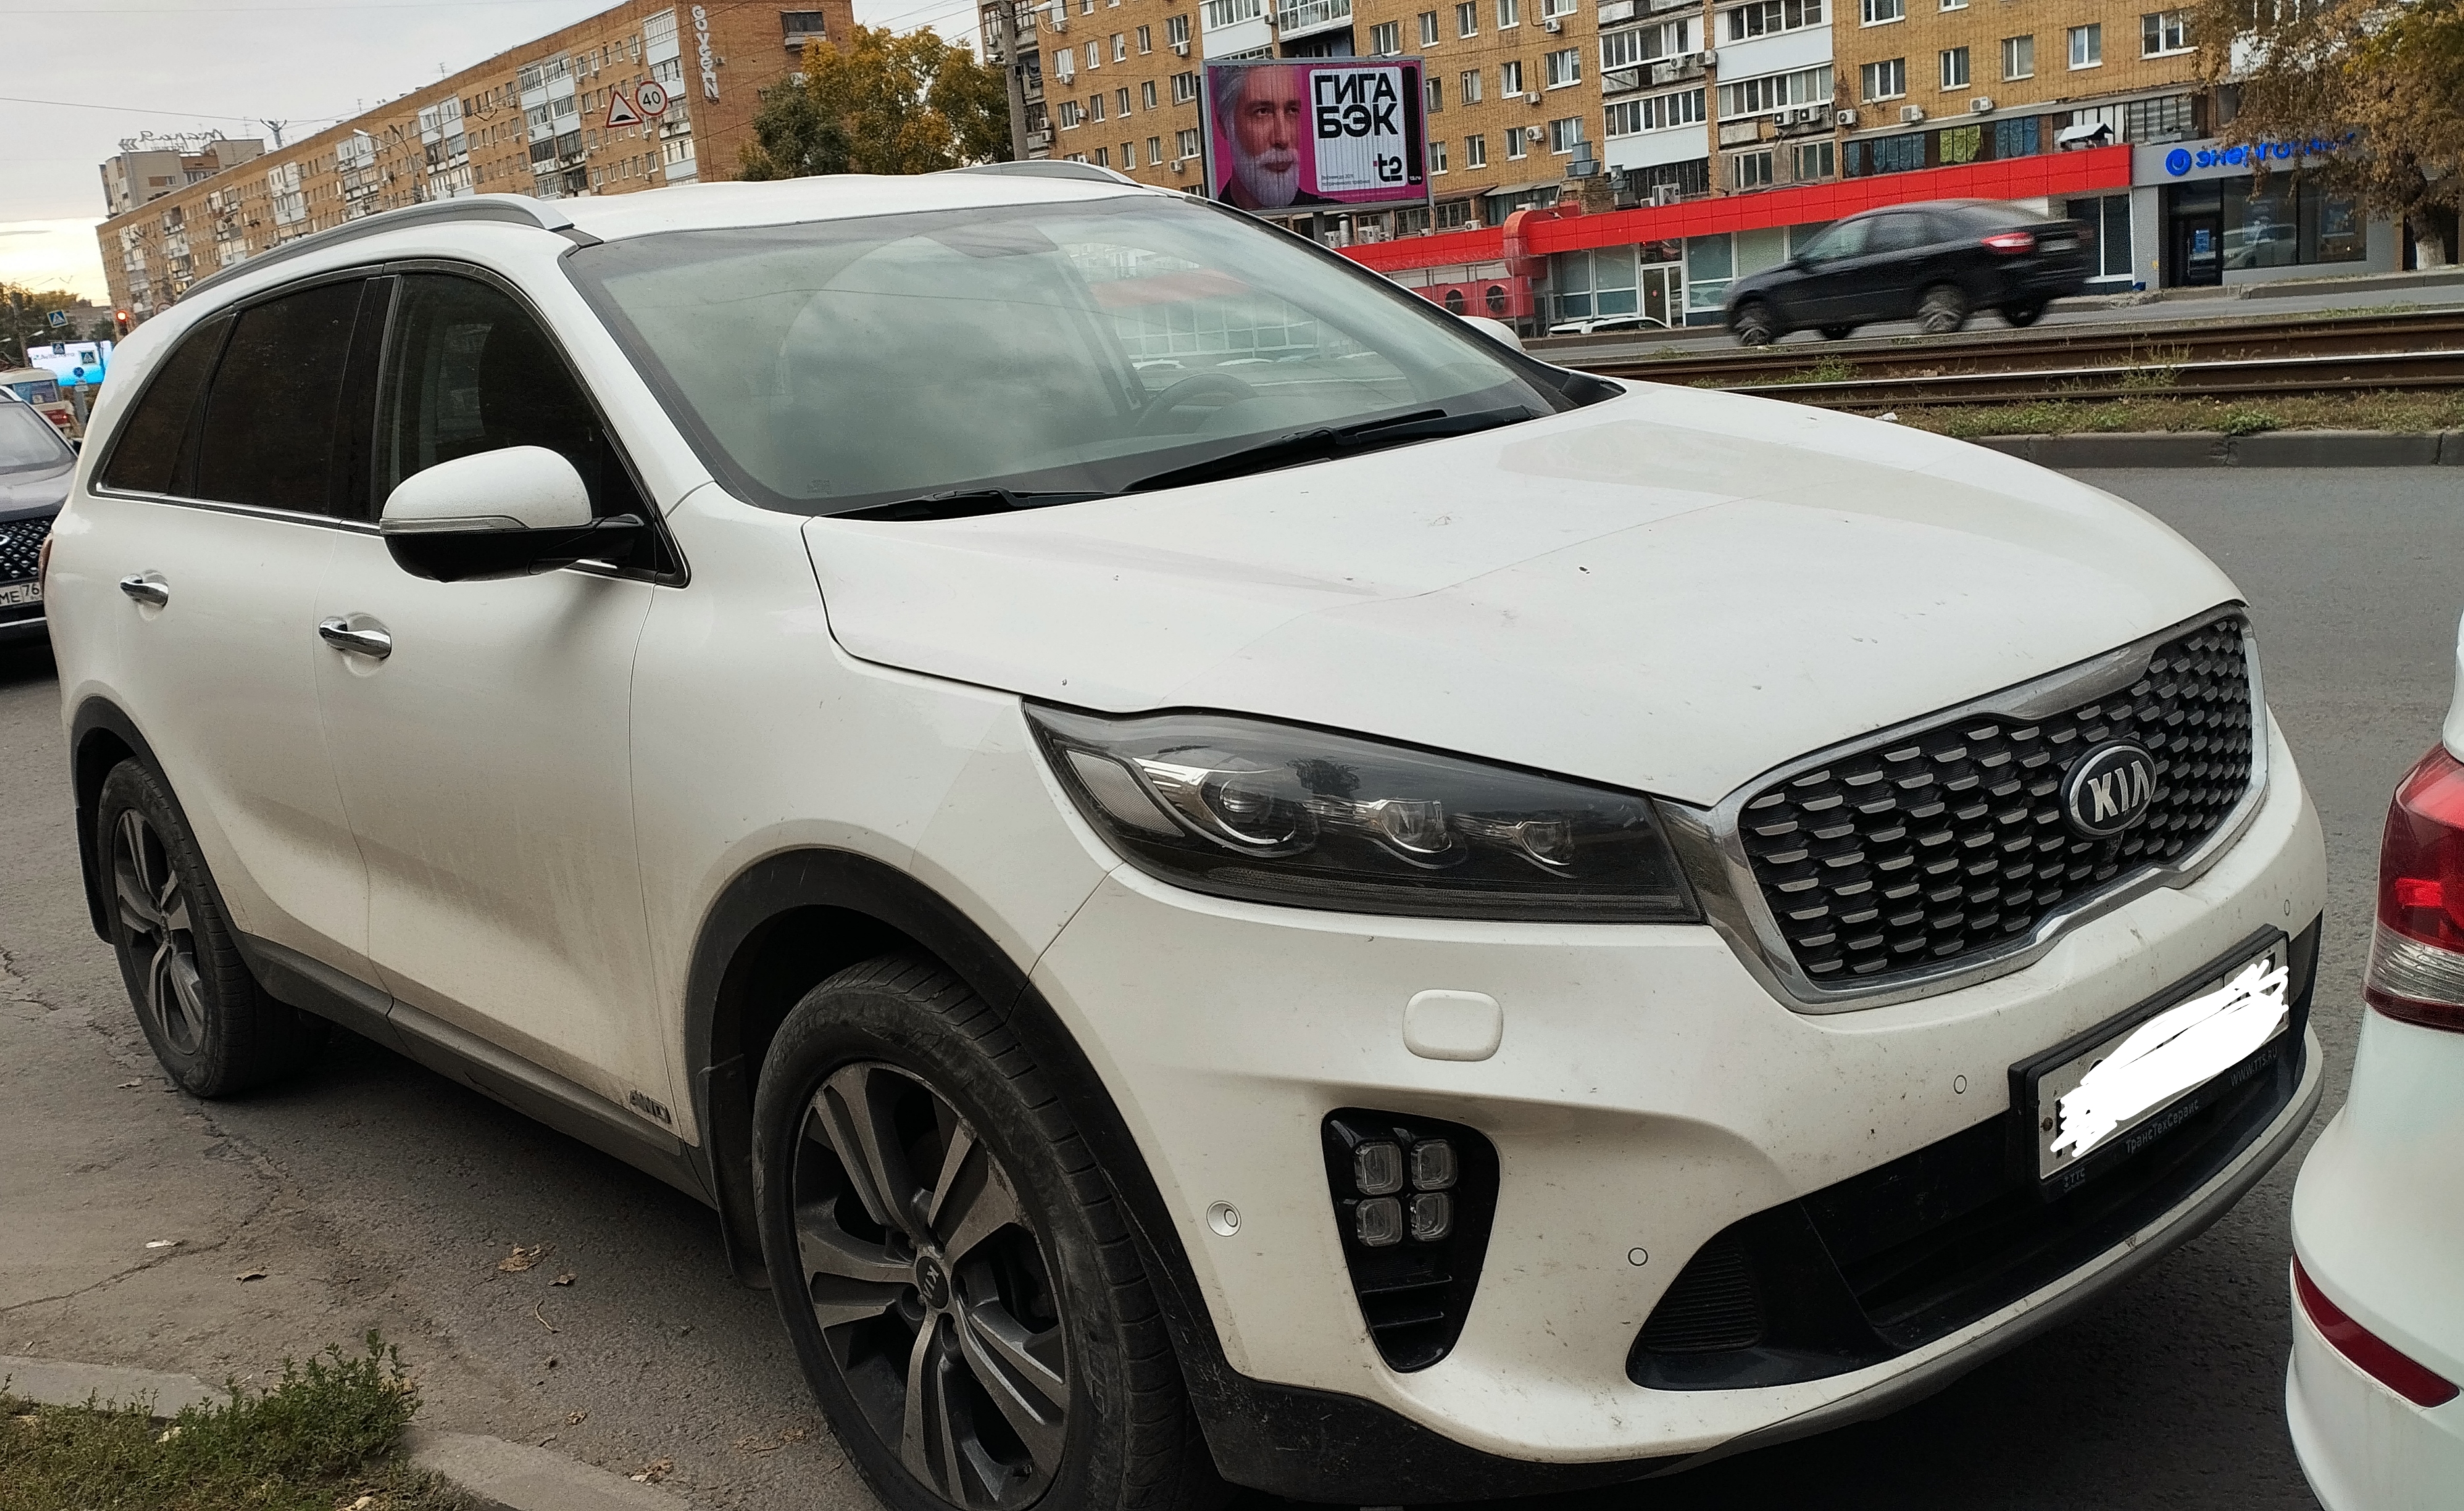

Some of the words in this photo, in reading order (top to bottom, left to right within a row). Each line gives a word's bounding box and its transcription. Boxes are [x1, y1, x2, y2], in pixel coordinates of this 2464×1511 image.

[643, 91, 661, 105] 40
[1315, 72, 1397, 105] ГИГА
[1316, 103, 1399, 140] БЭК
[1377, 153, 1403, 182] t2
[21, 582, 39, 597] 76
[2087, 759, 2150, 823] KIA
[2230, 1045, 2277, 1087] WWW.TTS.RU
[922, 1264, 940, 1300] KIA
